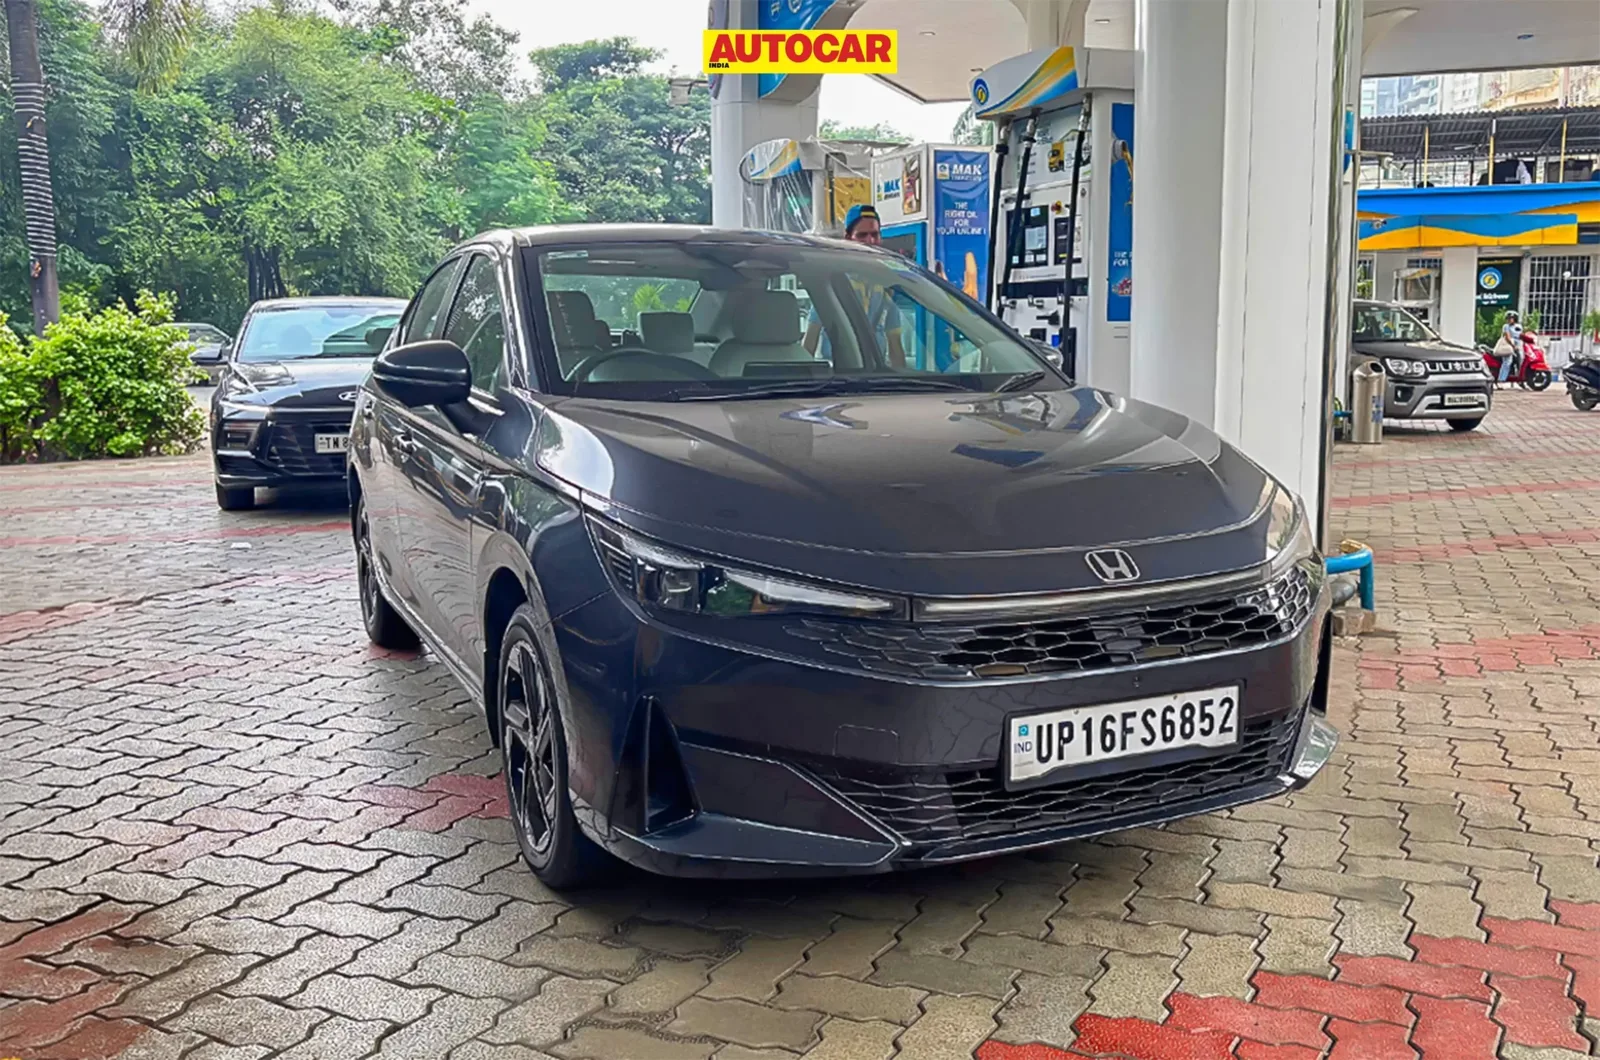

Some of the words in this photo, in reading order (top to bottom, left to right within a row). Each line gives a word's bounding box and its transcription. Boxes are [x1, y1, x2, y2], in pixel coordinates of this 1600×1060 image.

[952, 163, 982, 175] MAK
[954, 202, 969, 210] THE
[944, 210, 965, 218] RIGHT
[953, 218, 970, 227] FOR
[325, 436, 340, 449] TN
[1035, 696, 1235, 764] UP16FS6852
[1013, 741, 1033, 754] IND
